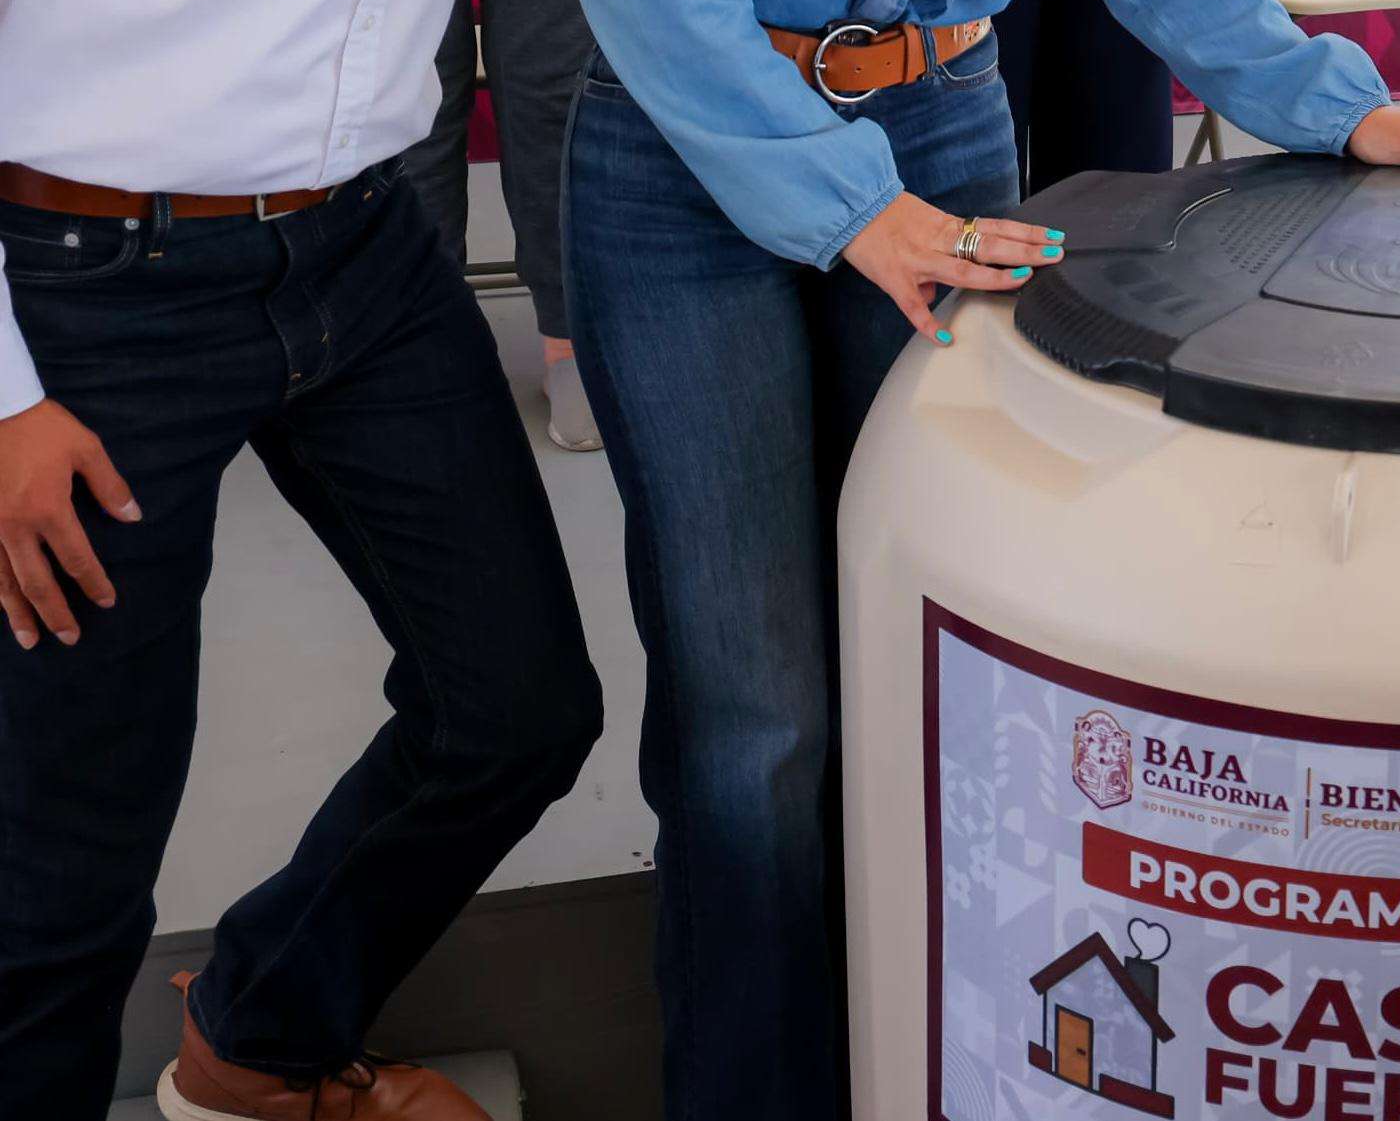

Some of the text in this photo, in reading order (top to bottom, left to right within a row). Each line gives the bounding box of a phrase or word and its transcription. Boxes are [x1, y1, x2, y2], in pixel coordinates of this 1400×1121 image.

[1143, 736, 1247, 783] BAJA
[1142, 769, 1290, 812] CALIFORNIA
[1142, 799, 1290, 837] GOBIERNO DEL ESTADO
